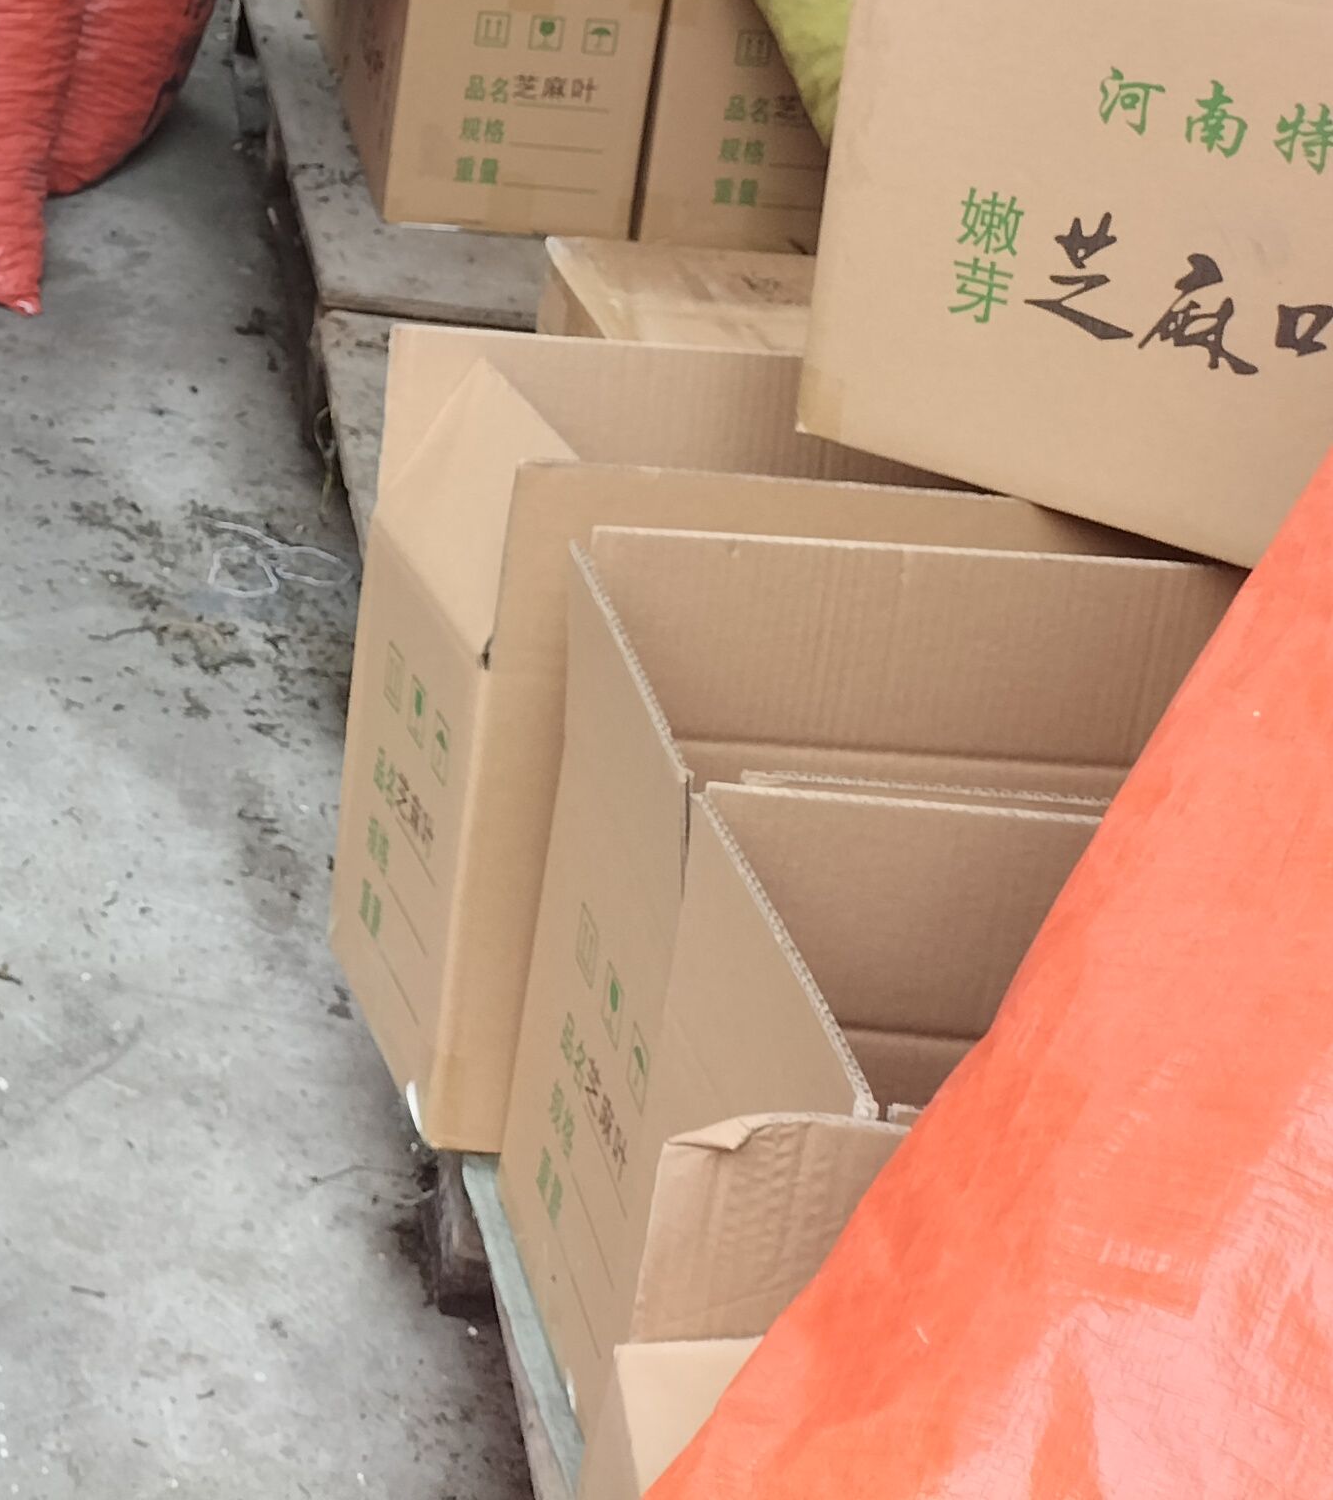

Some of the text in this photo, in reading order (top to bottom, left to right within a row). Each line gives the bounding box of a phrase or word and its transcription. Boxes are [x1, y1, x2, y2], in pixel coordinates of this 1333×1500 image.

[463, 73, 598, 105] 品名芝麻叶
[459, 117, 506, 145] 规格
[1098, 66, 1333, 175] 河南特
[453, 157, 500, 187] 重量
[947, 186, 1026, 325] 嫩芽
